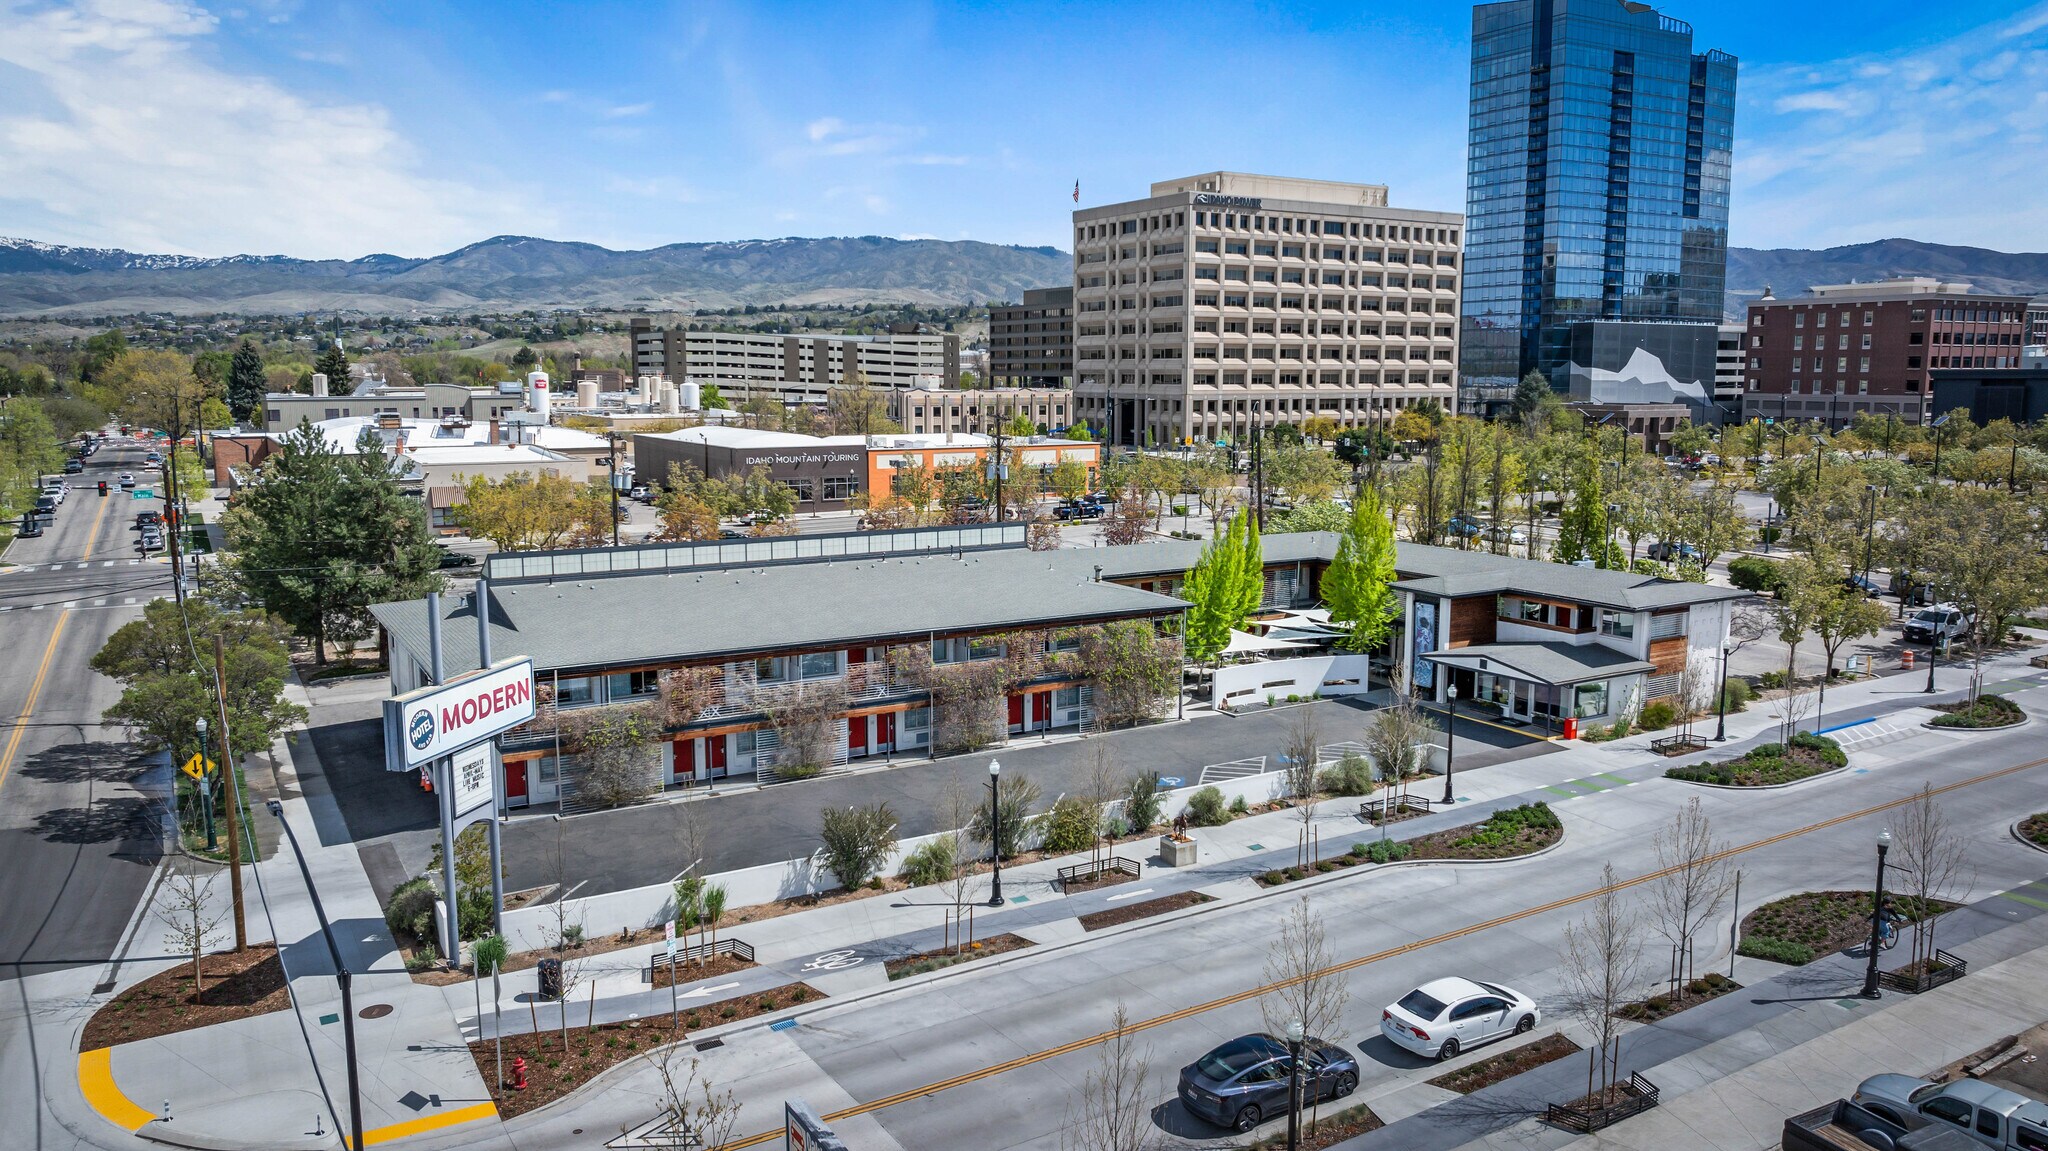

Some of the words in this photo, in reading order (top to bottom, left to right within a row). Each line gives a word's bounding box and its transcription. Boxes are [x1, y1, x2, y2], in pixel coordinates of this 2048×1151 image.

[1208, 194, 1232, 206] IDAHO
[1233, 196, 1262, 208] POWER
[746, 456, 774, 464] IDAHO
[776, 454, 821, 464] MOUNTAIN
[823, 453, 860, 462] TOURING
[442, 678, 530, 735] MODERN
[411, 710, 428, 728] MODERN
[411, 719, 434, 743] HOTEL
[462, 758, 485, 773] WEDNESDAYS
[463, 778, 471, 787] LIVE
[472, 772, 485, 783] MUSIC
